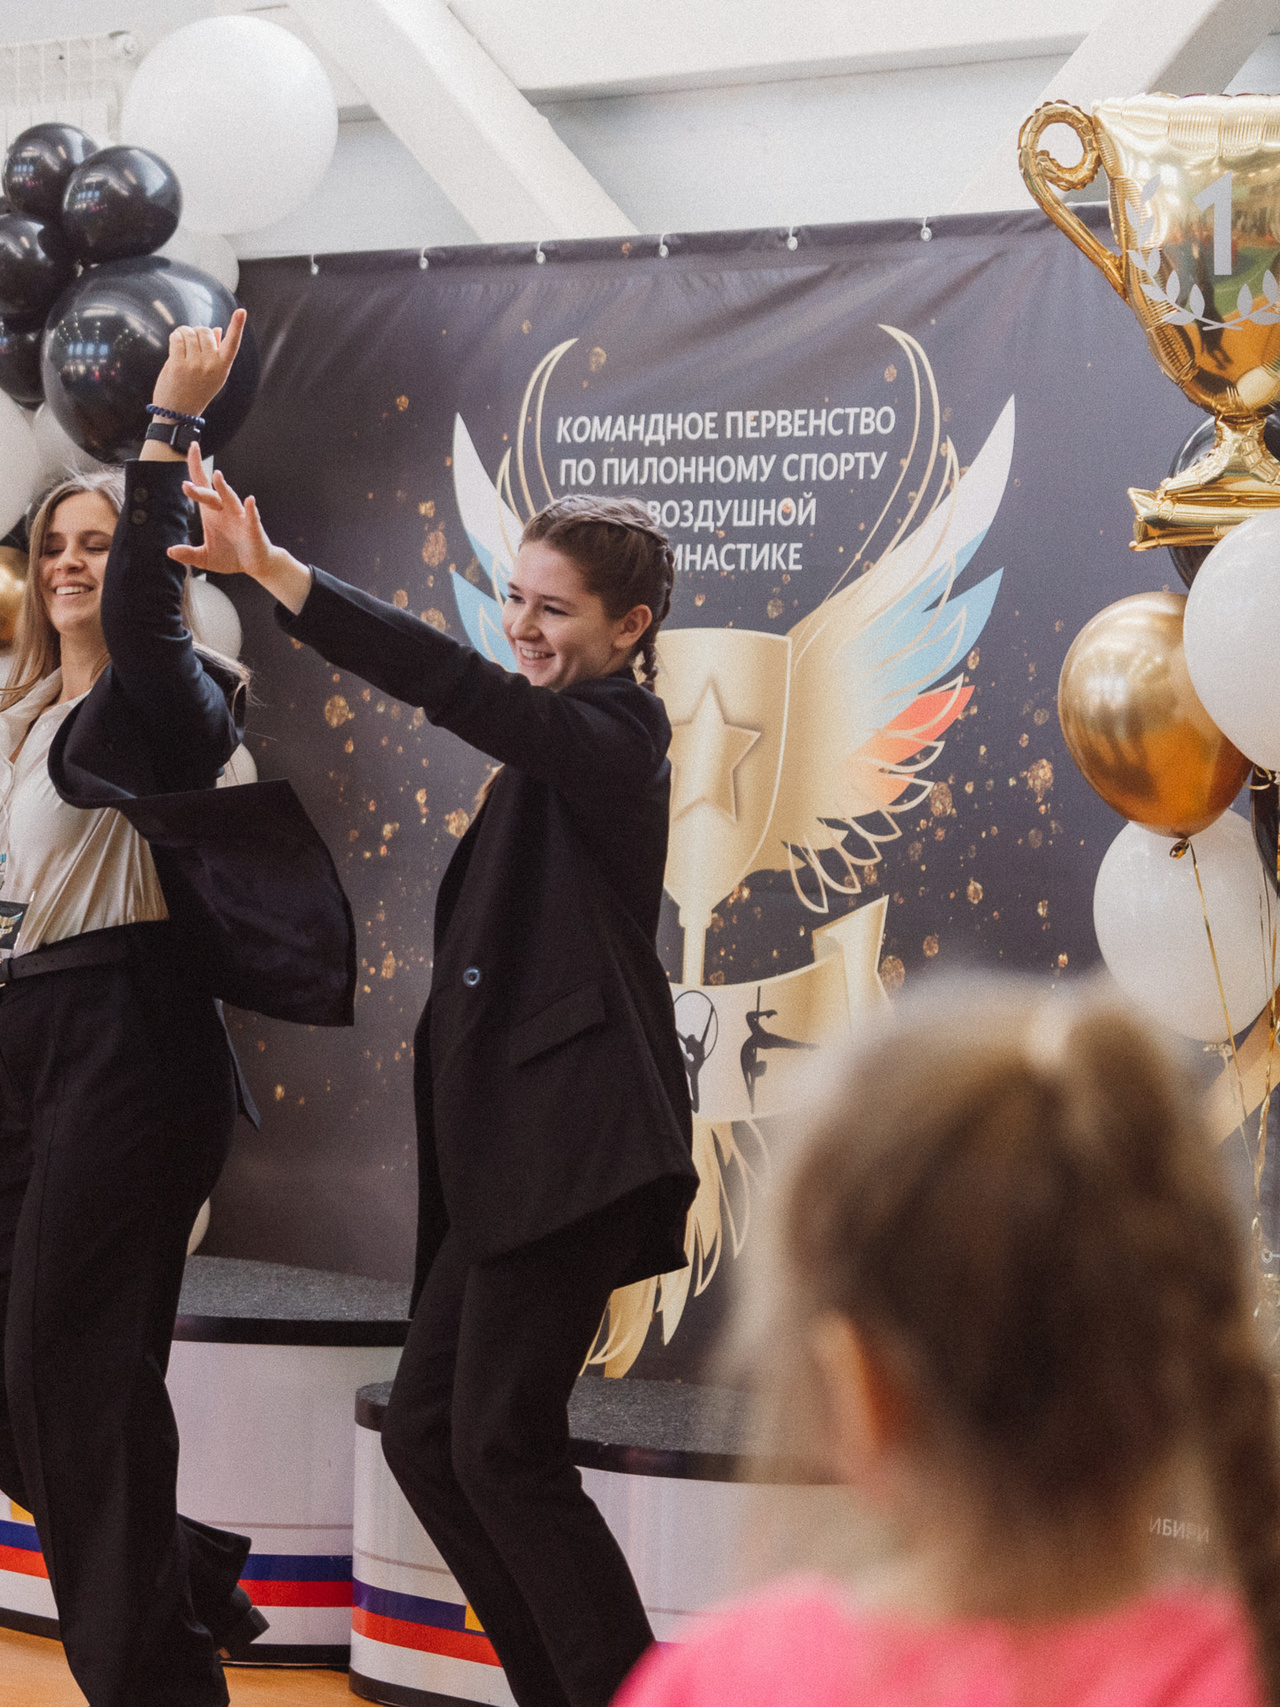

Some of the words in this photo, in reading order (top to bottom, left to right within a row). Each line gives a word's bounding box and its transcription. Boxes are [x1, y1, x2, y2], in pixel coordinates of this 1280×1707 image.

[1193, 169, 1232, 275] 1
[557, 412, 719, 446] КОМАНДНОЕ
[726, 406, 896, 439] ПЕРВЕНСТВО
[559, 458, 597, 487] ПО
[601, 452, 777, 487] ПИЛОННОМУ
[781, 451, 889, 483] СПОРТУ
[647, 492, 817, 532] ВОЗДУШНОЙ
[672, 542, 803, 571] НАСТИКЕ
